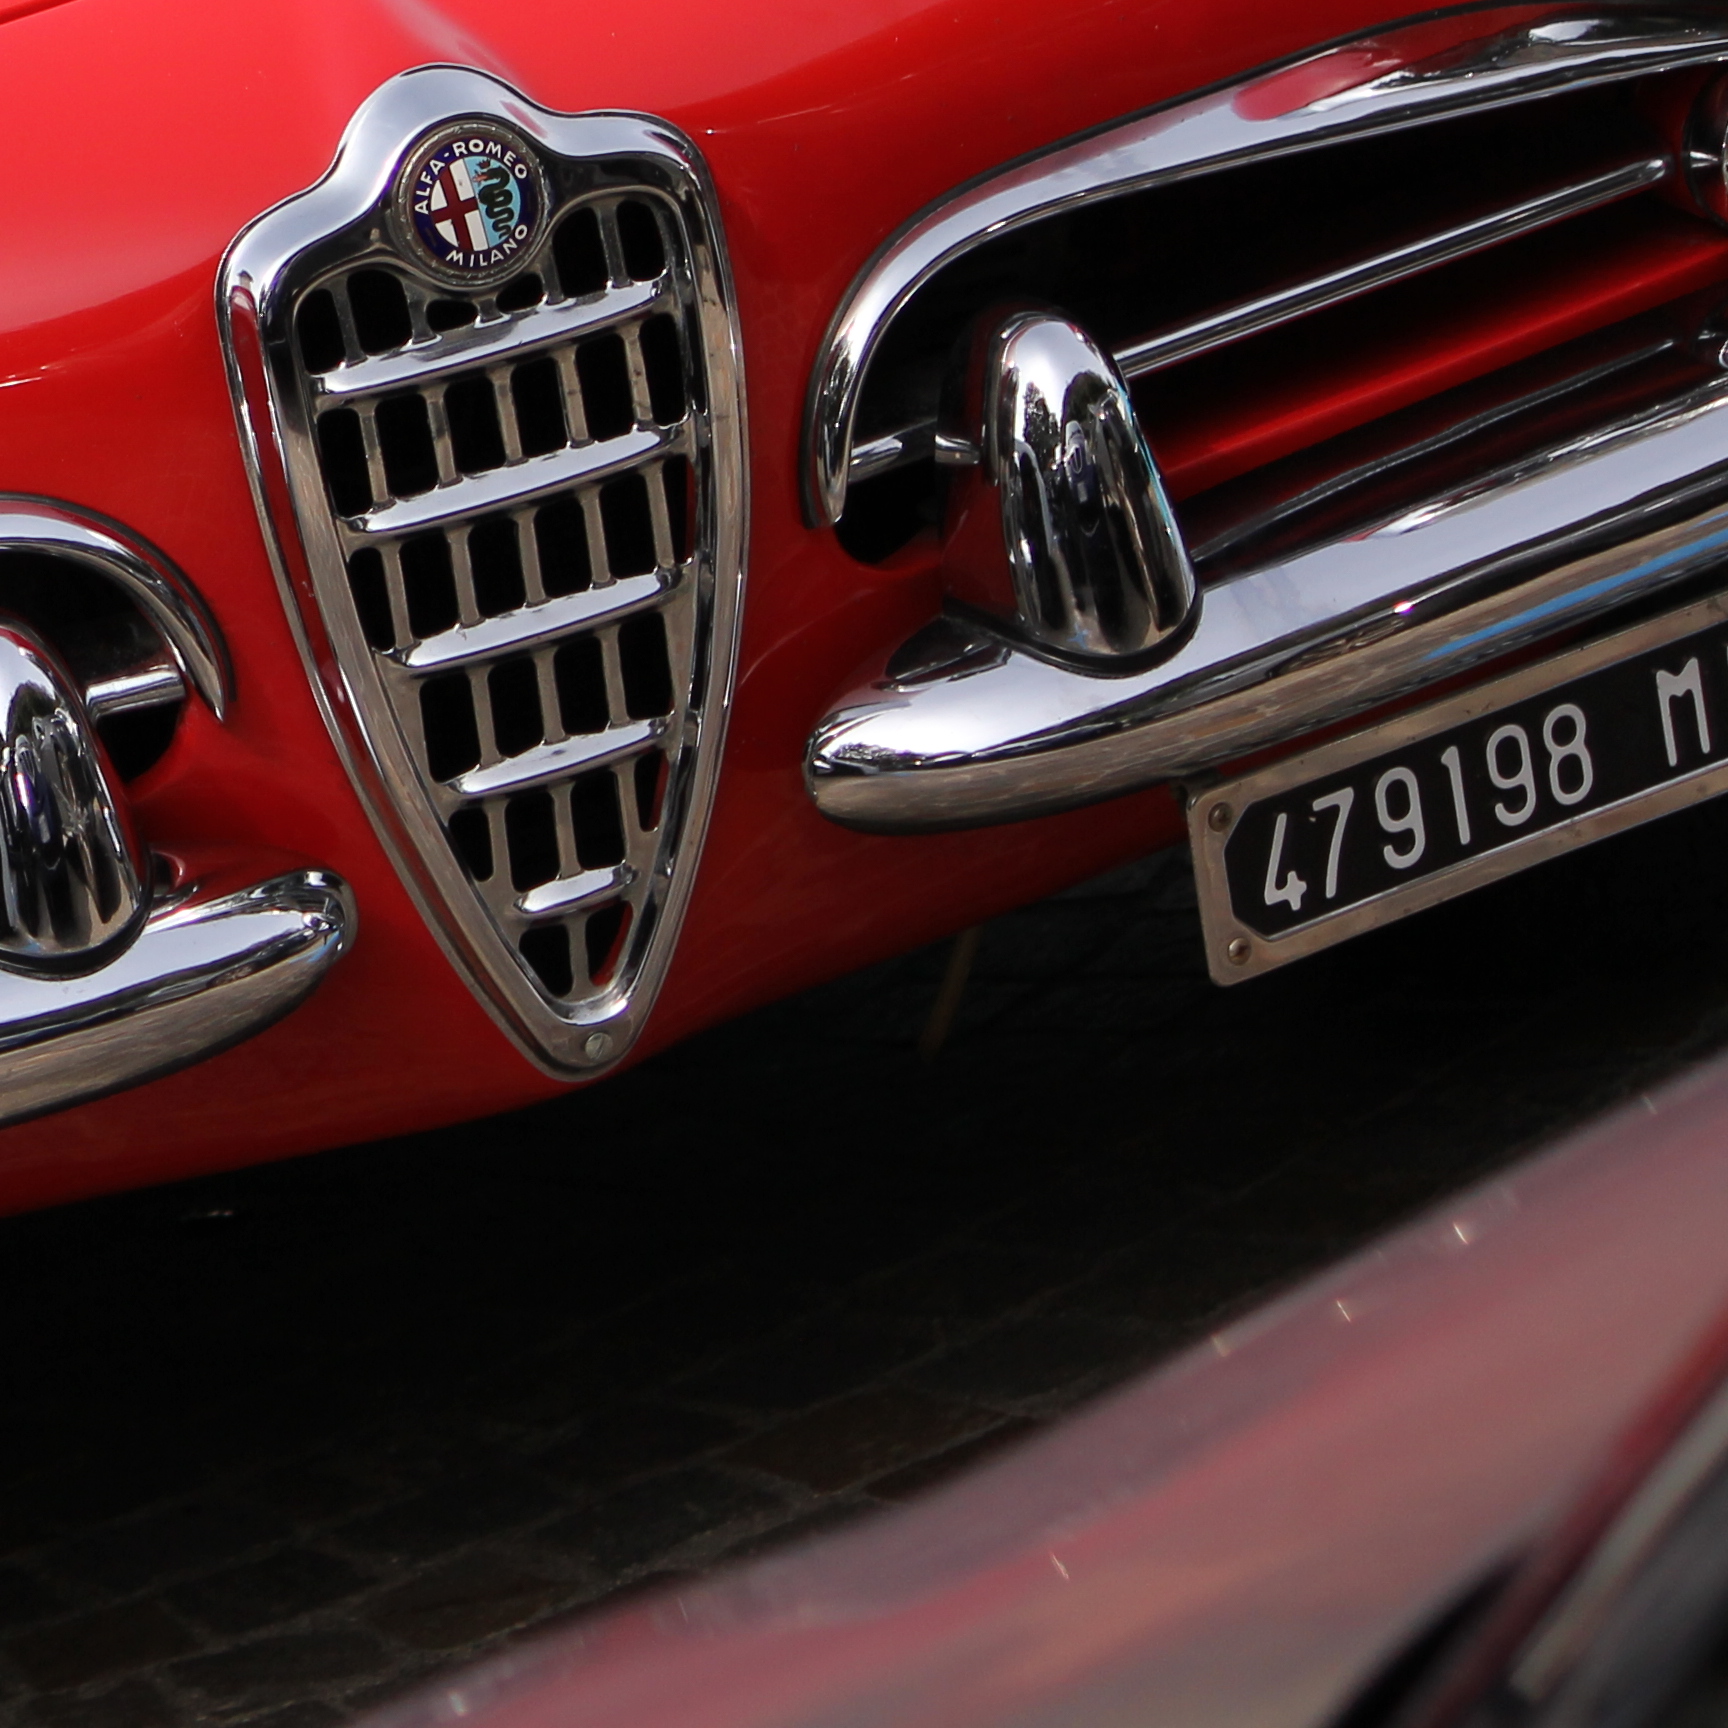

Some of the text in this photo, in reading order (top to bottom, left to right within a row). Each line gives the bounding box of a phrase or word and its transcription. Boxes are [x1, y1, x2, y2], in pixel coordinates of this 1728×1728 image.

[446, 224, 528, 267] MILANO
[1264, 652, 1728, 911] 479198 M
